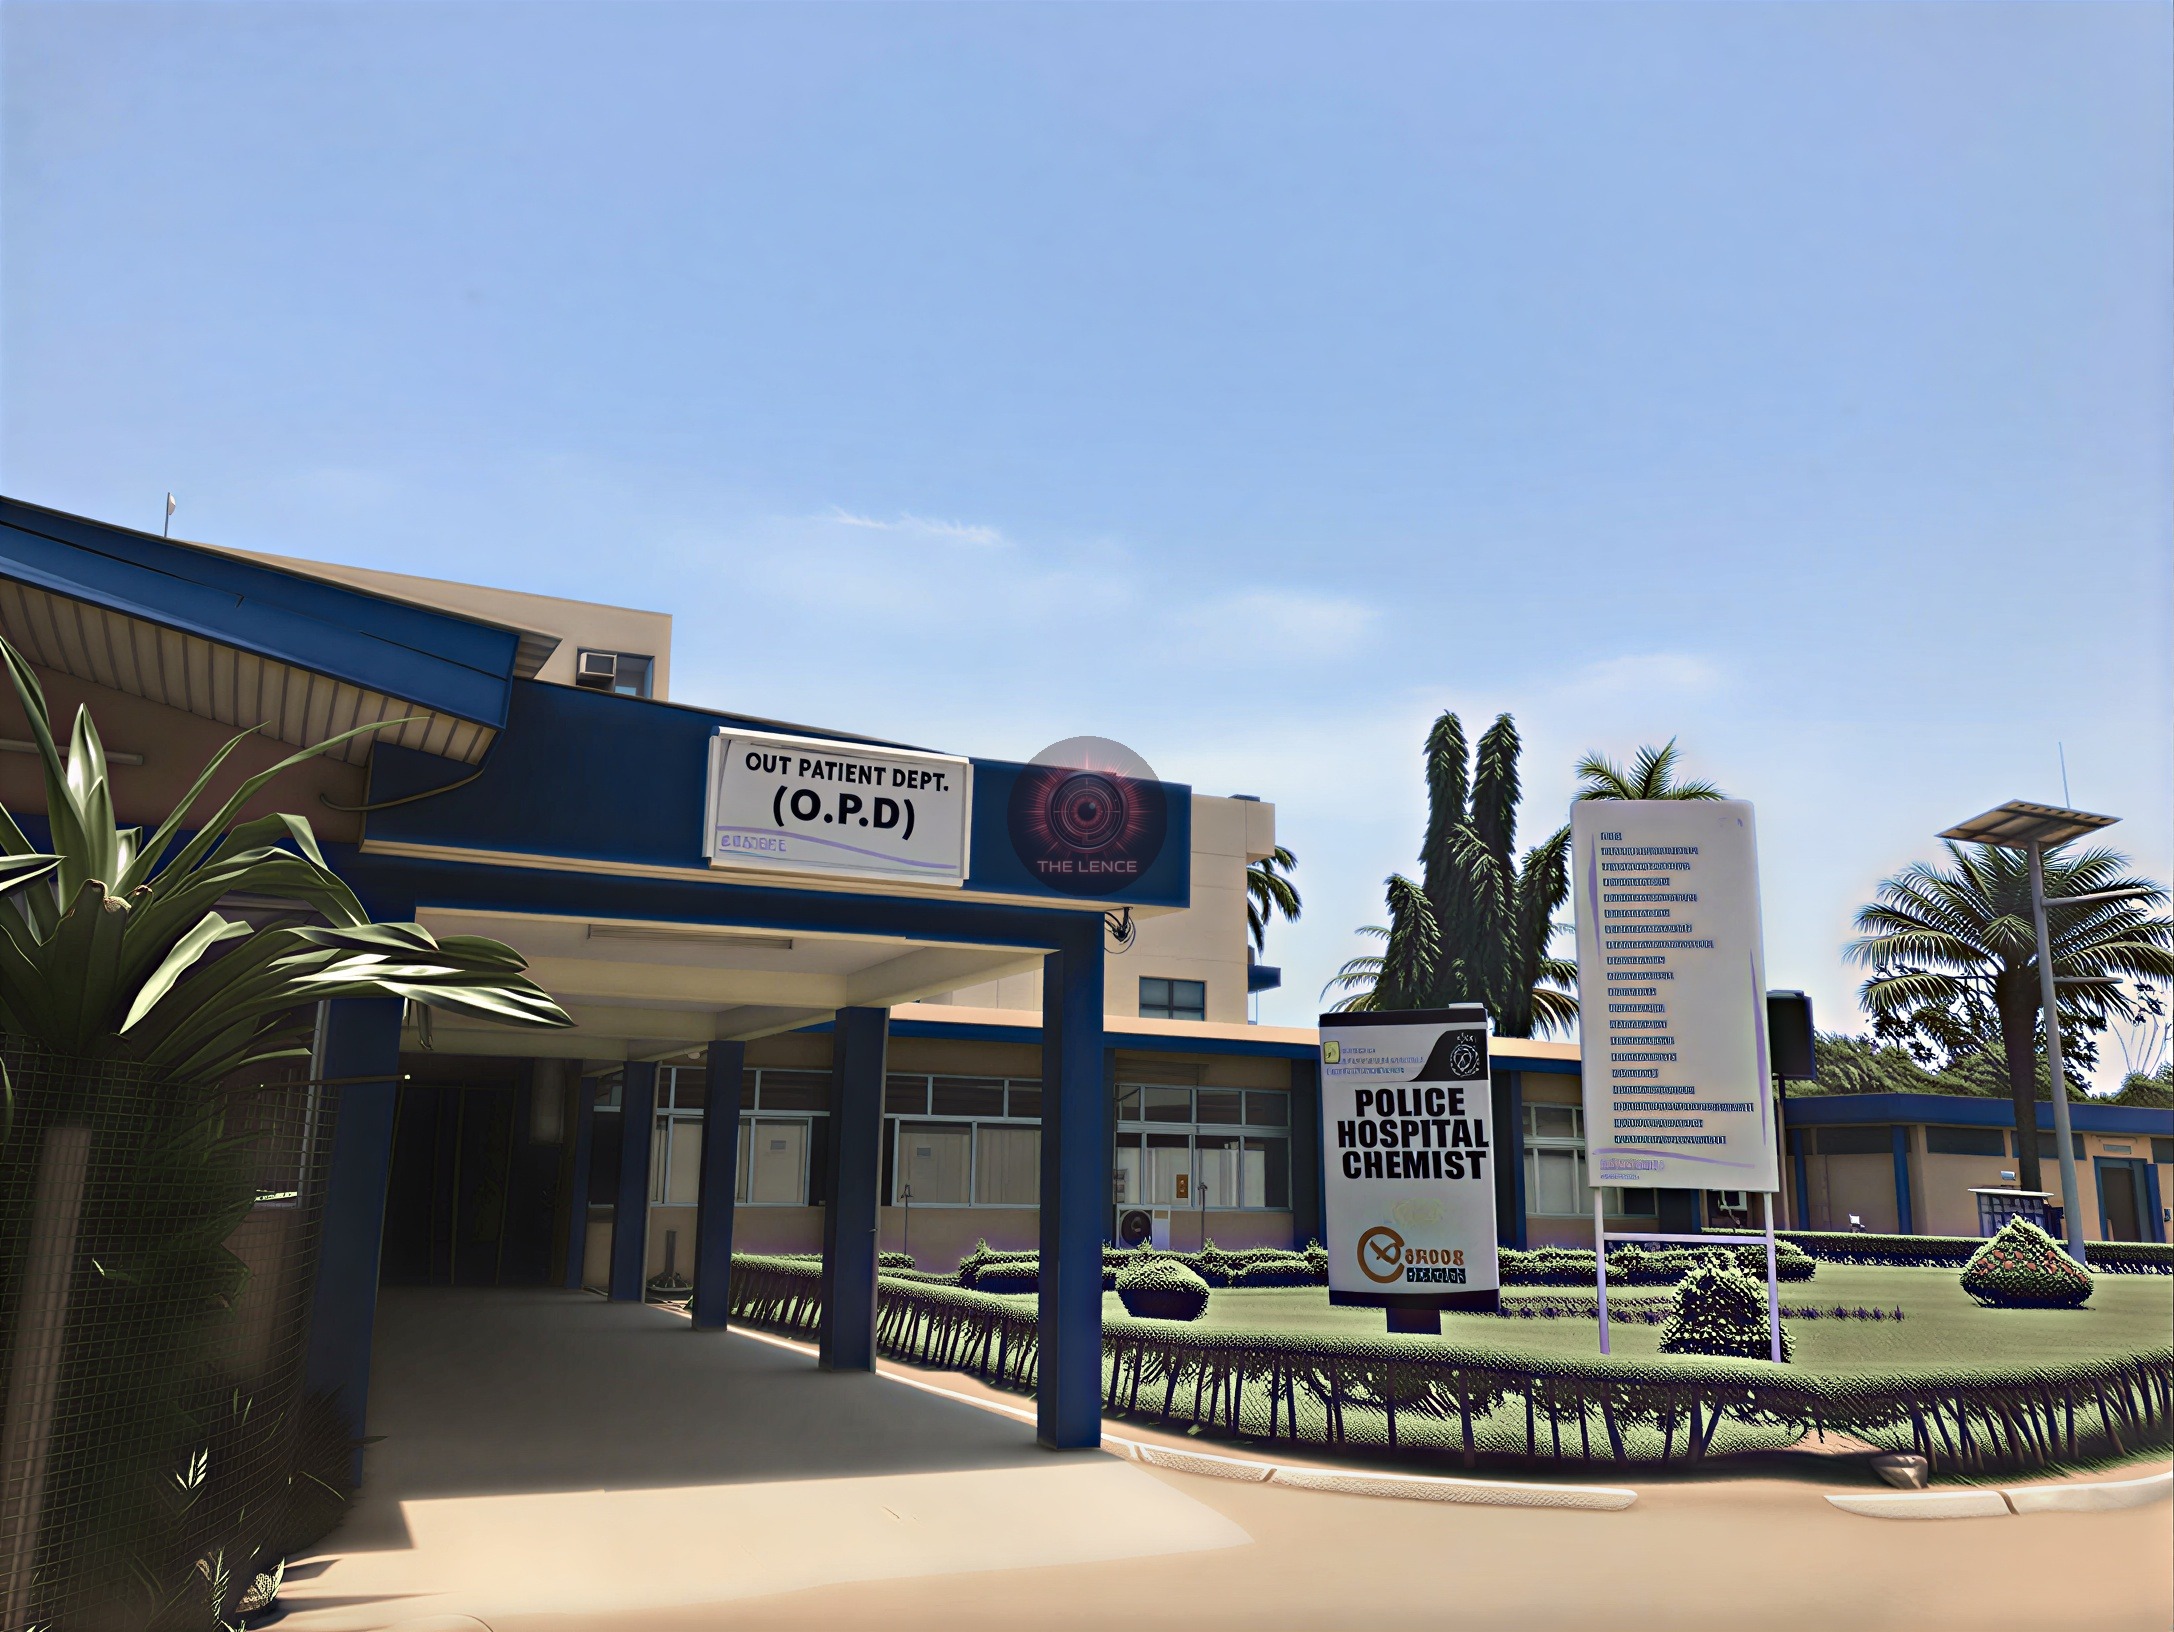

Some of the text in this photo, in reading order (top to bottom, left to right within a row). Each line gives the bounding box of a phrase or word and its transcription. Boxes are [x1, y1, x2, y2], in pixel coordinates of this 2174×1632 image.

[746, 753, 948, 791] OUT PATIENT DEPT.
[773, 785, 915, 840] (O.P.D)
[1355, 1088, 1465, 1117] POLICE
[1337, 1119, 1489, 1148] HOSPITAL
[1343, 1151, 1486, 1179] CHEMIST
